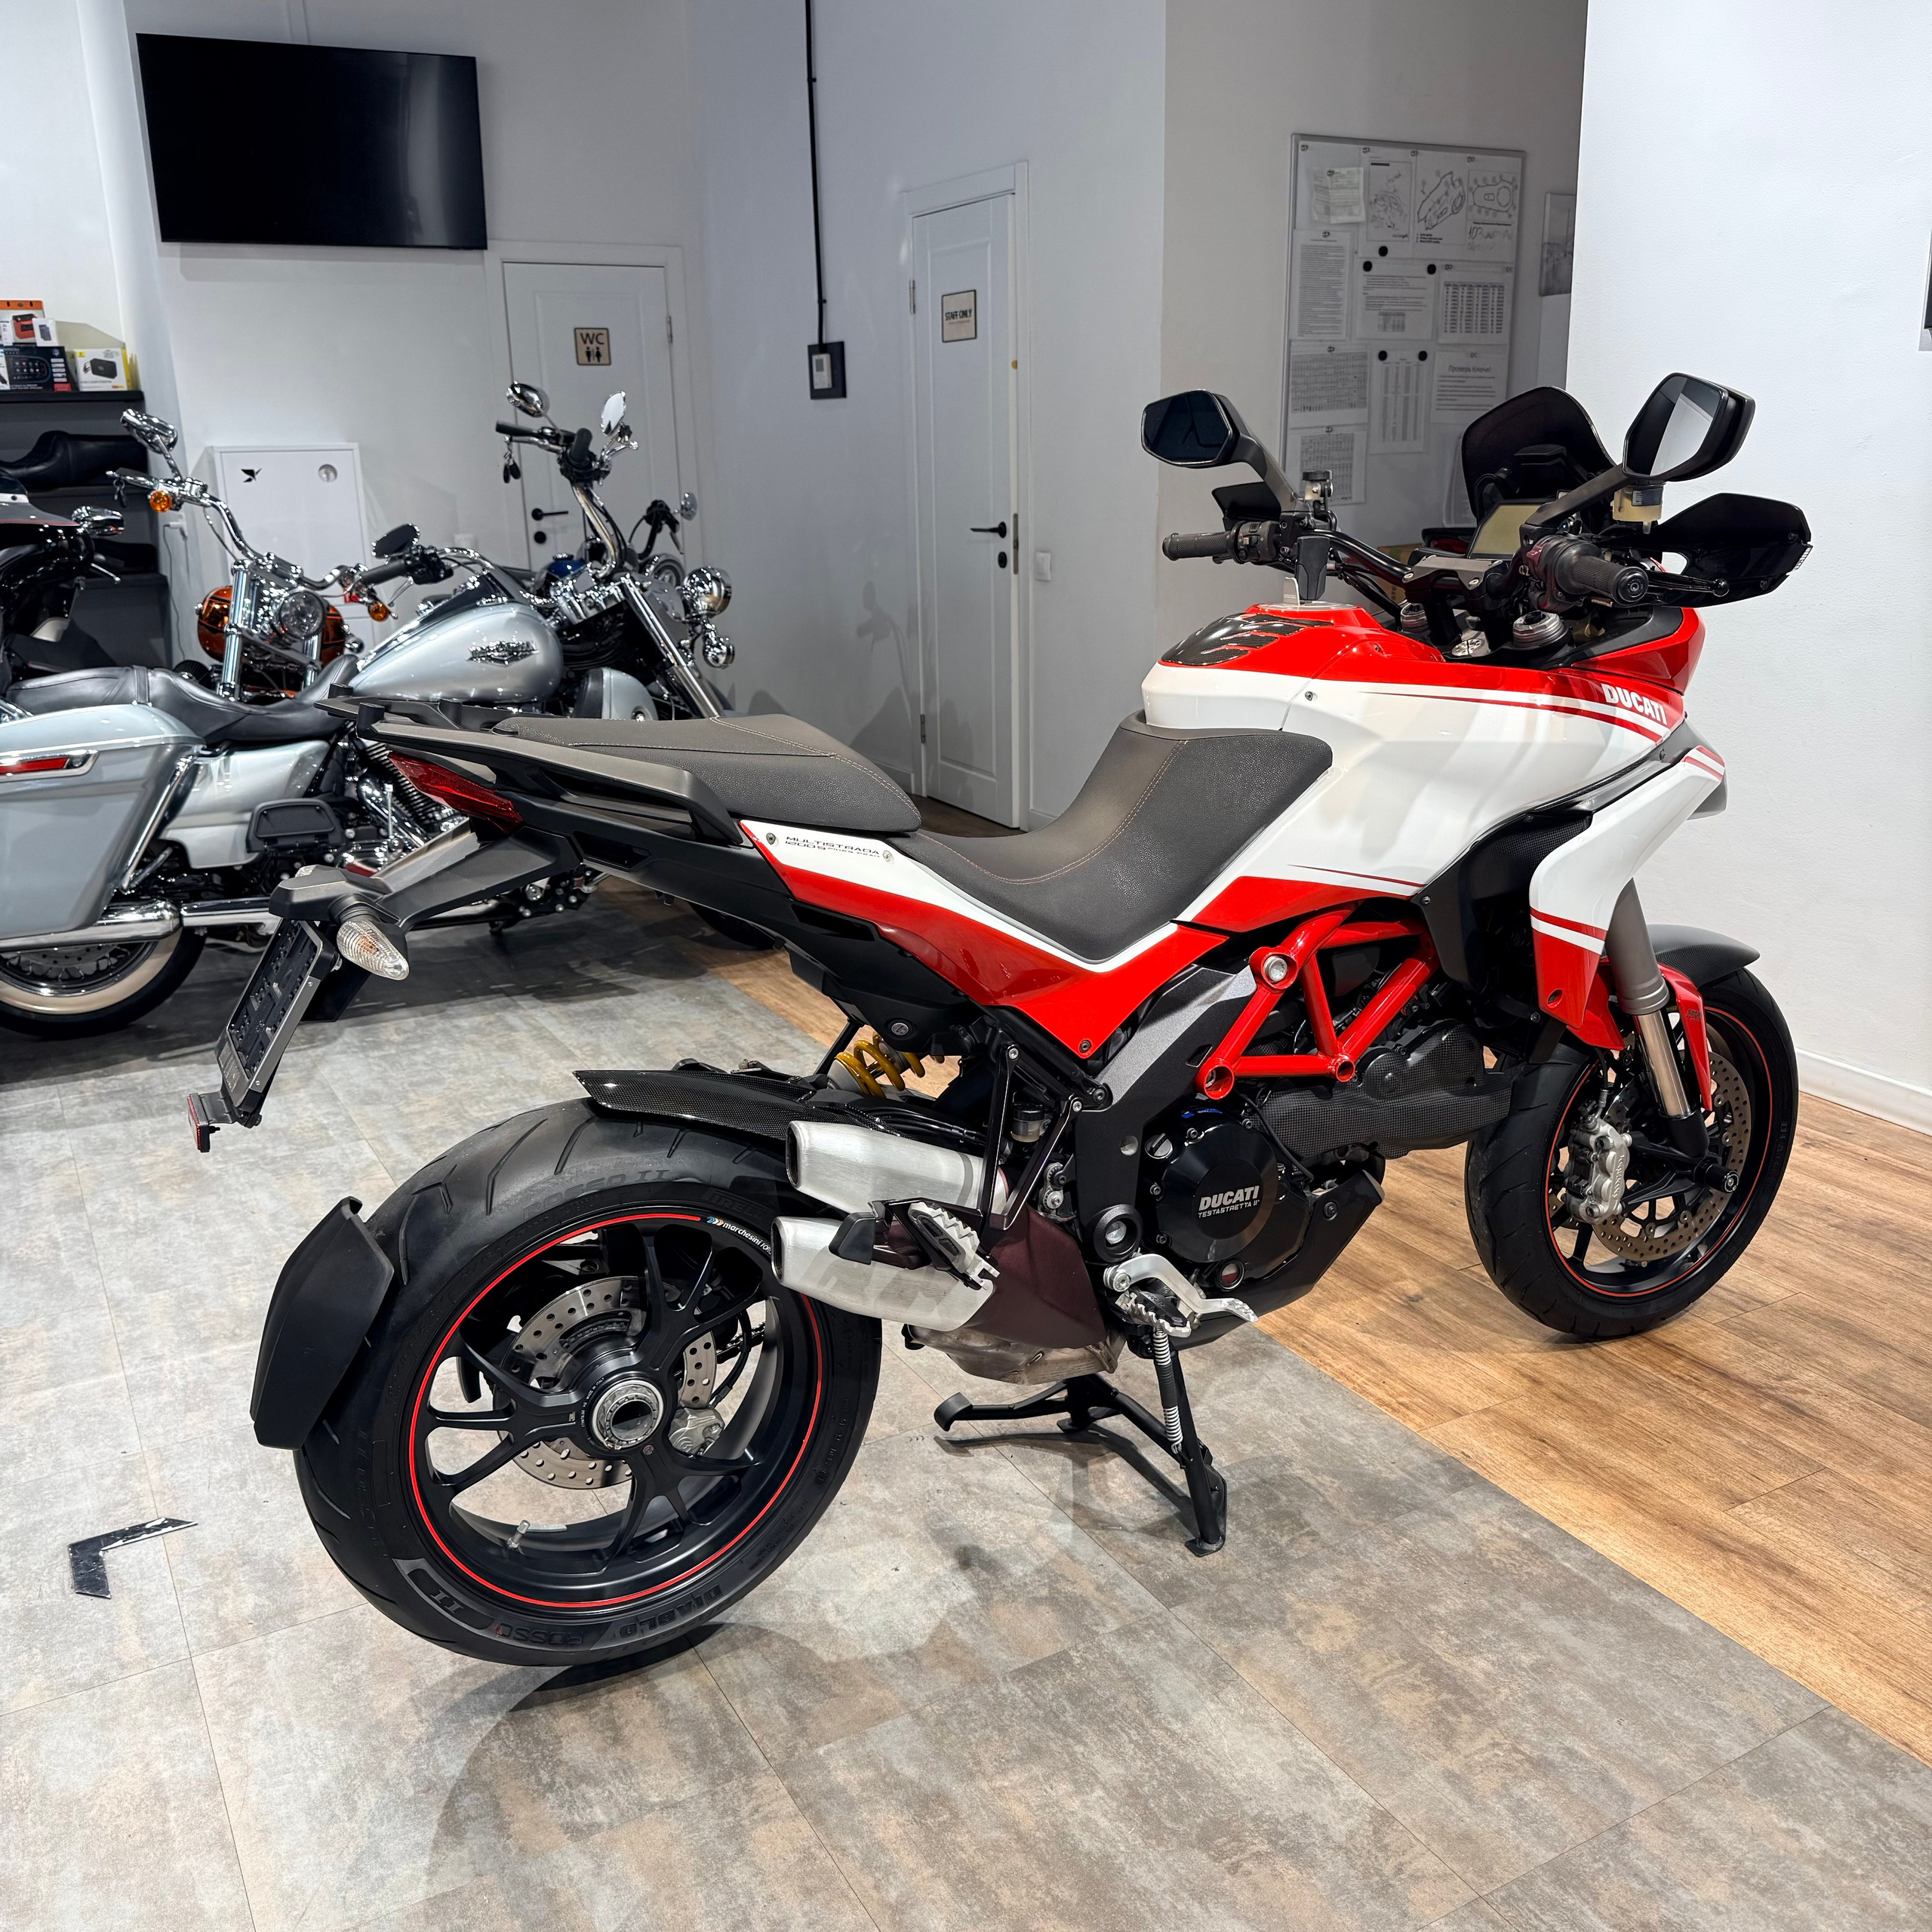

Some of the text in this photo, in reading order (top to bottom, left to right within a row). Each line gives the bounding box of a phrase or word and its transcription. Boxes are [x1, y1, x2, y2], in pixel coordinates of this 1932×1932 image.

[945, 309, 972, 321] STAFF ONLY
[580, 333, 605, 345] WC
[1601, 683, 1668, 725] DUCATI
[786, 836, 879, 854] MULTISTRADA
[1198, 1186, 1260, 1211] DUCATI
[1198, 1203, 1251, 1218] TESTASTRETTA
[722, 1222, 762, 1245] marchesini
[619, 1584, 723, 1638] DIABLO
[496, 1623, 584, 1645] ROSSO
